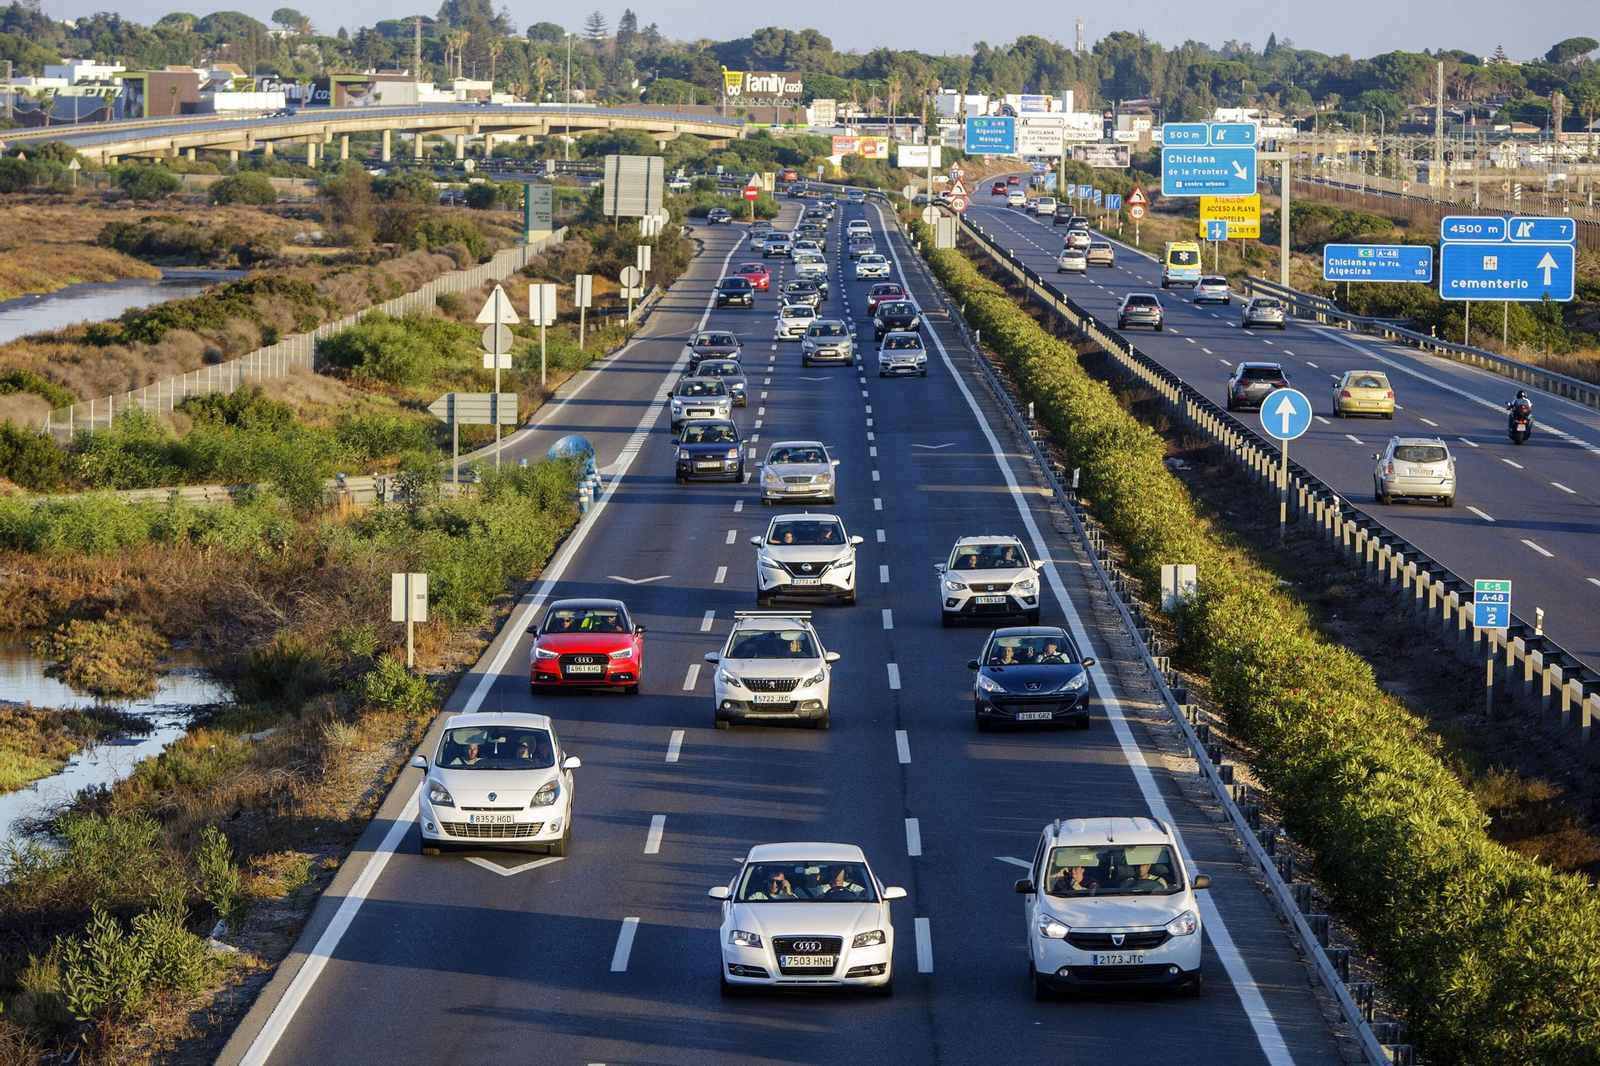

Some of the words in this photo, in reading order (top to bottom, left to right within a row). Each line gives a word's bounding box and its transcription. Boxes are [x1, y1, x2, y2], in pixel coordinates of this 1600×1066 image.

[746, 73, 786, 97] family
[785, 80, 803, 92] cash
[1168, 155, 1216, 163] Chiclana
[1450, 225, 1482, 233] 4500
[1560, 226, 1567, 234] 7
[1329, 268, 1371, 276] Algeciras
[1451, 279, 1528, 289] cementerio
[1487, 614, 1496, 624] 2
[788, 957, 811, 965] 7503
[814, 957, 831, 965] HNH
[1100, 956, 1123, 964] 2173
[1126, 955, 1144, 964] JTC
